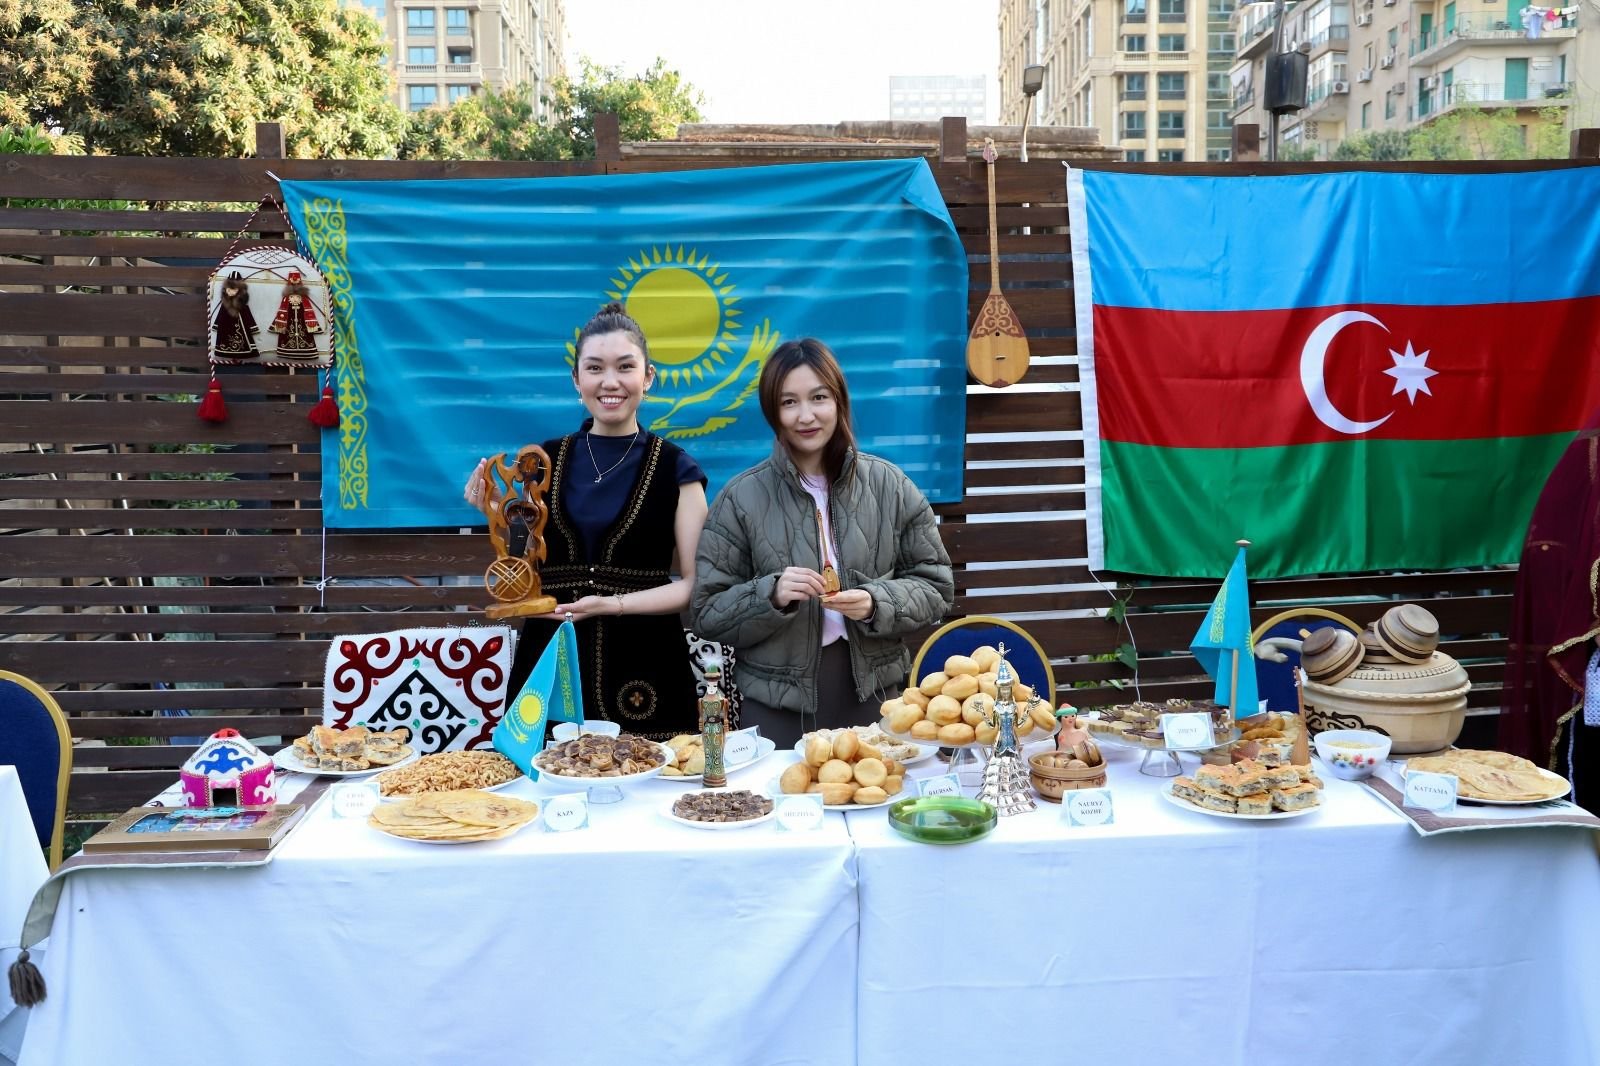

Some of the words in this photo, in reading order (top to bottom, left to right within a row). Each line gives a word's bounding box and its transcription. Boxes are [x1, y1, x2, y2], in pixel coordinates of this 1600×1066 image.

[928, 786, 954, 796] BAURSAK
[1414, 785, 1448, 795] KATTAMA
[1080, 808, 1102, 816] KOZHE
